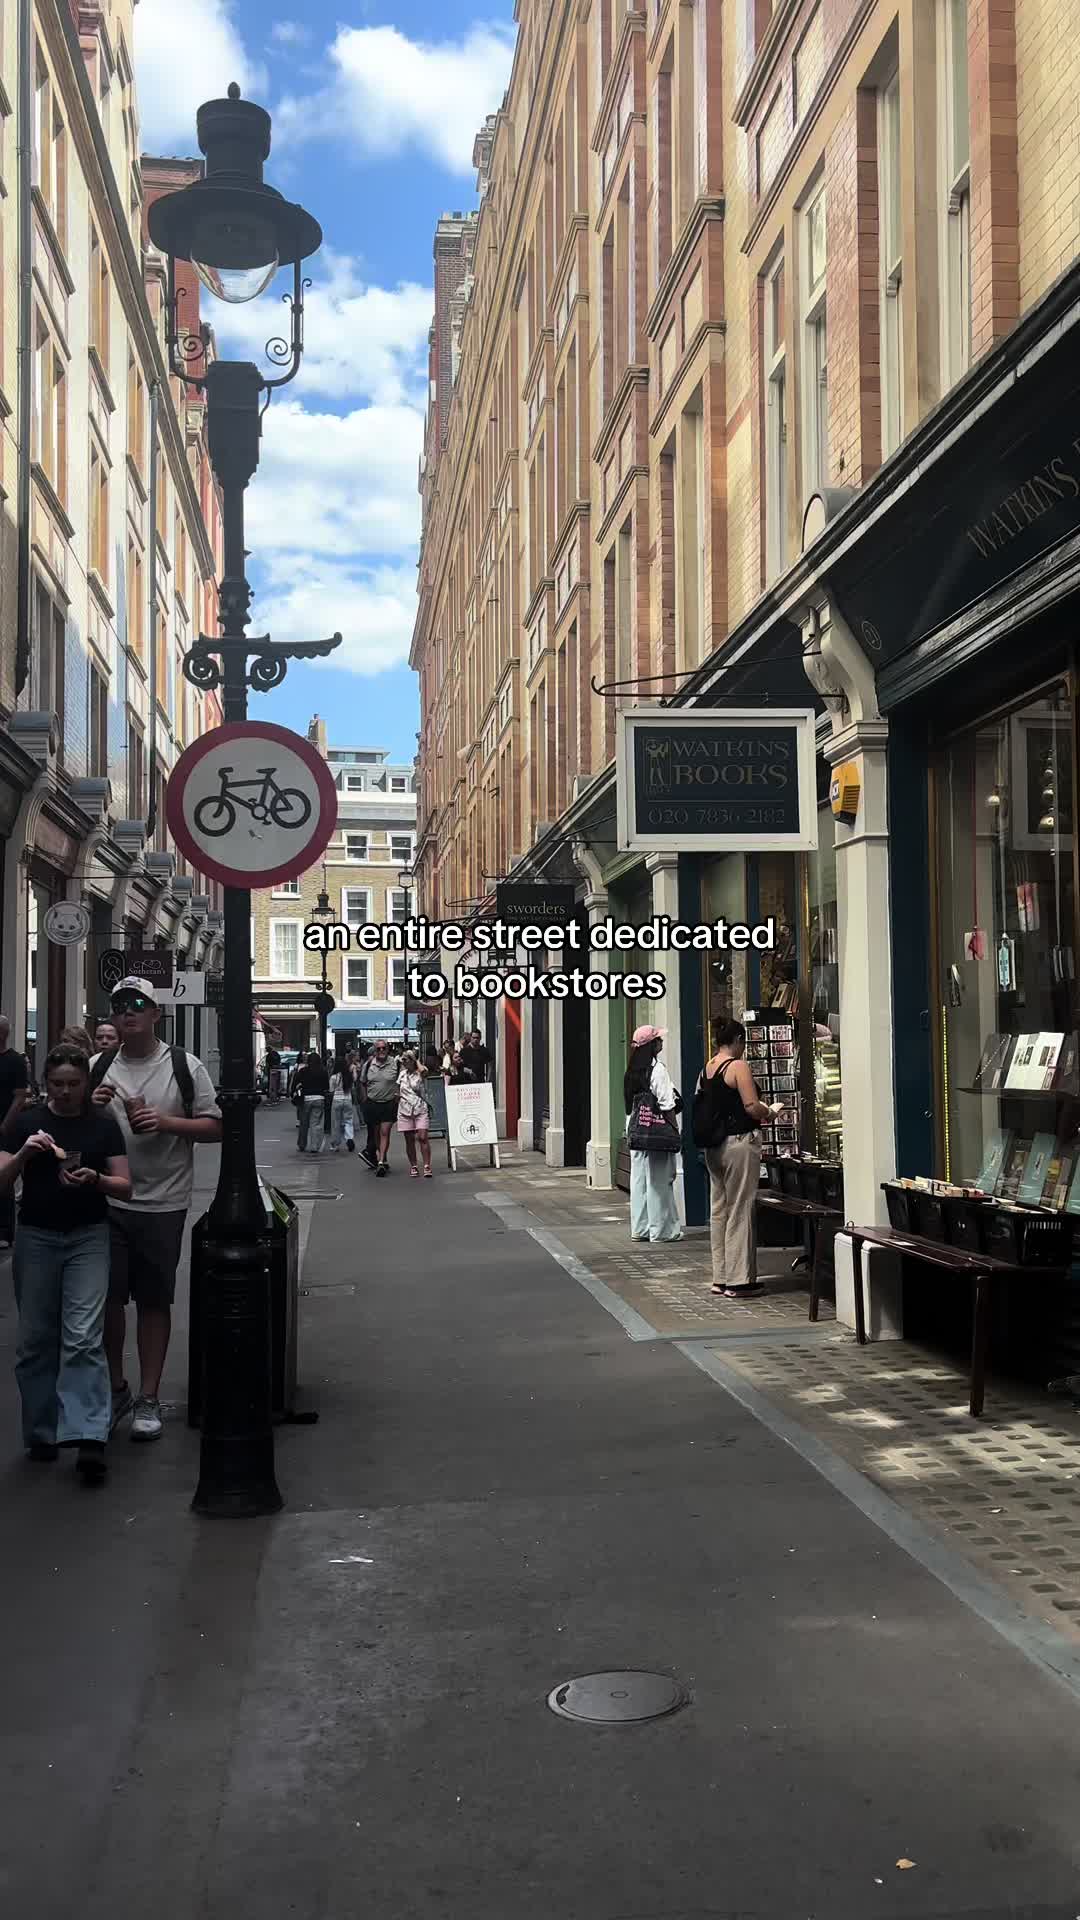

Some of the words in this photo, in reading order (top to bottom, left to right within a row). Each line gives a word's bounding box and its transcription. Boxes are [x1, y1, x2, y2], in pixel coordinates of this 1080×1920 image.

[967, 455, 1080, 558] WATKINS
[671, 740, 790, 758] WATKINS
[671, 764, 789, 789] BOOKS
[648, 808, 689, 825] 020
[744, 808, 785, 825] 2182
[506, 901, 566, 914] sworders
[172, 977, 187, 998] b
